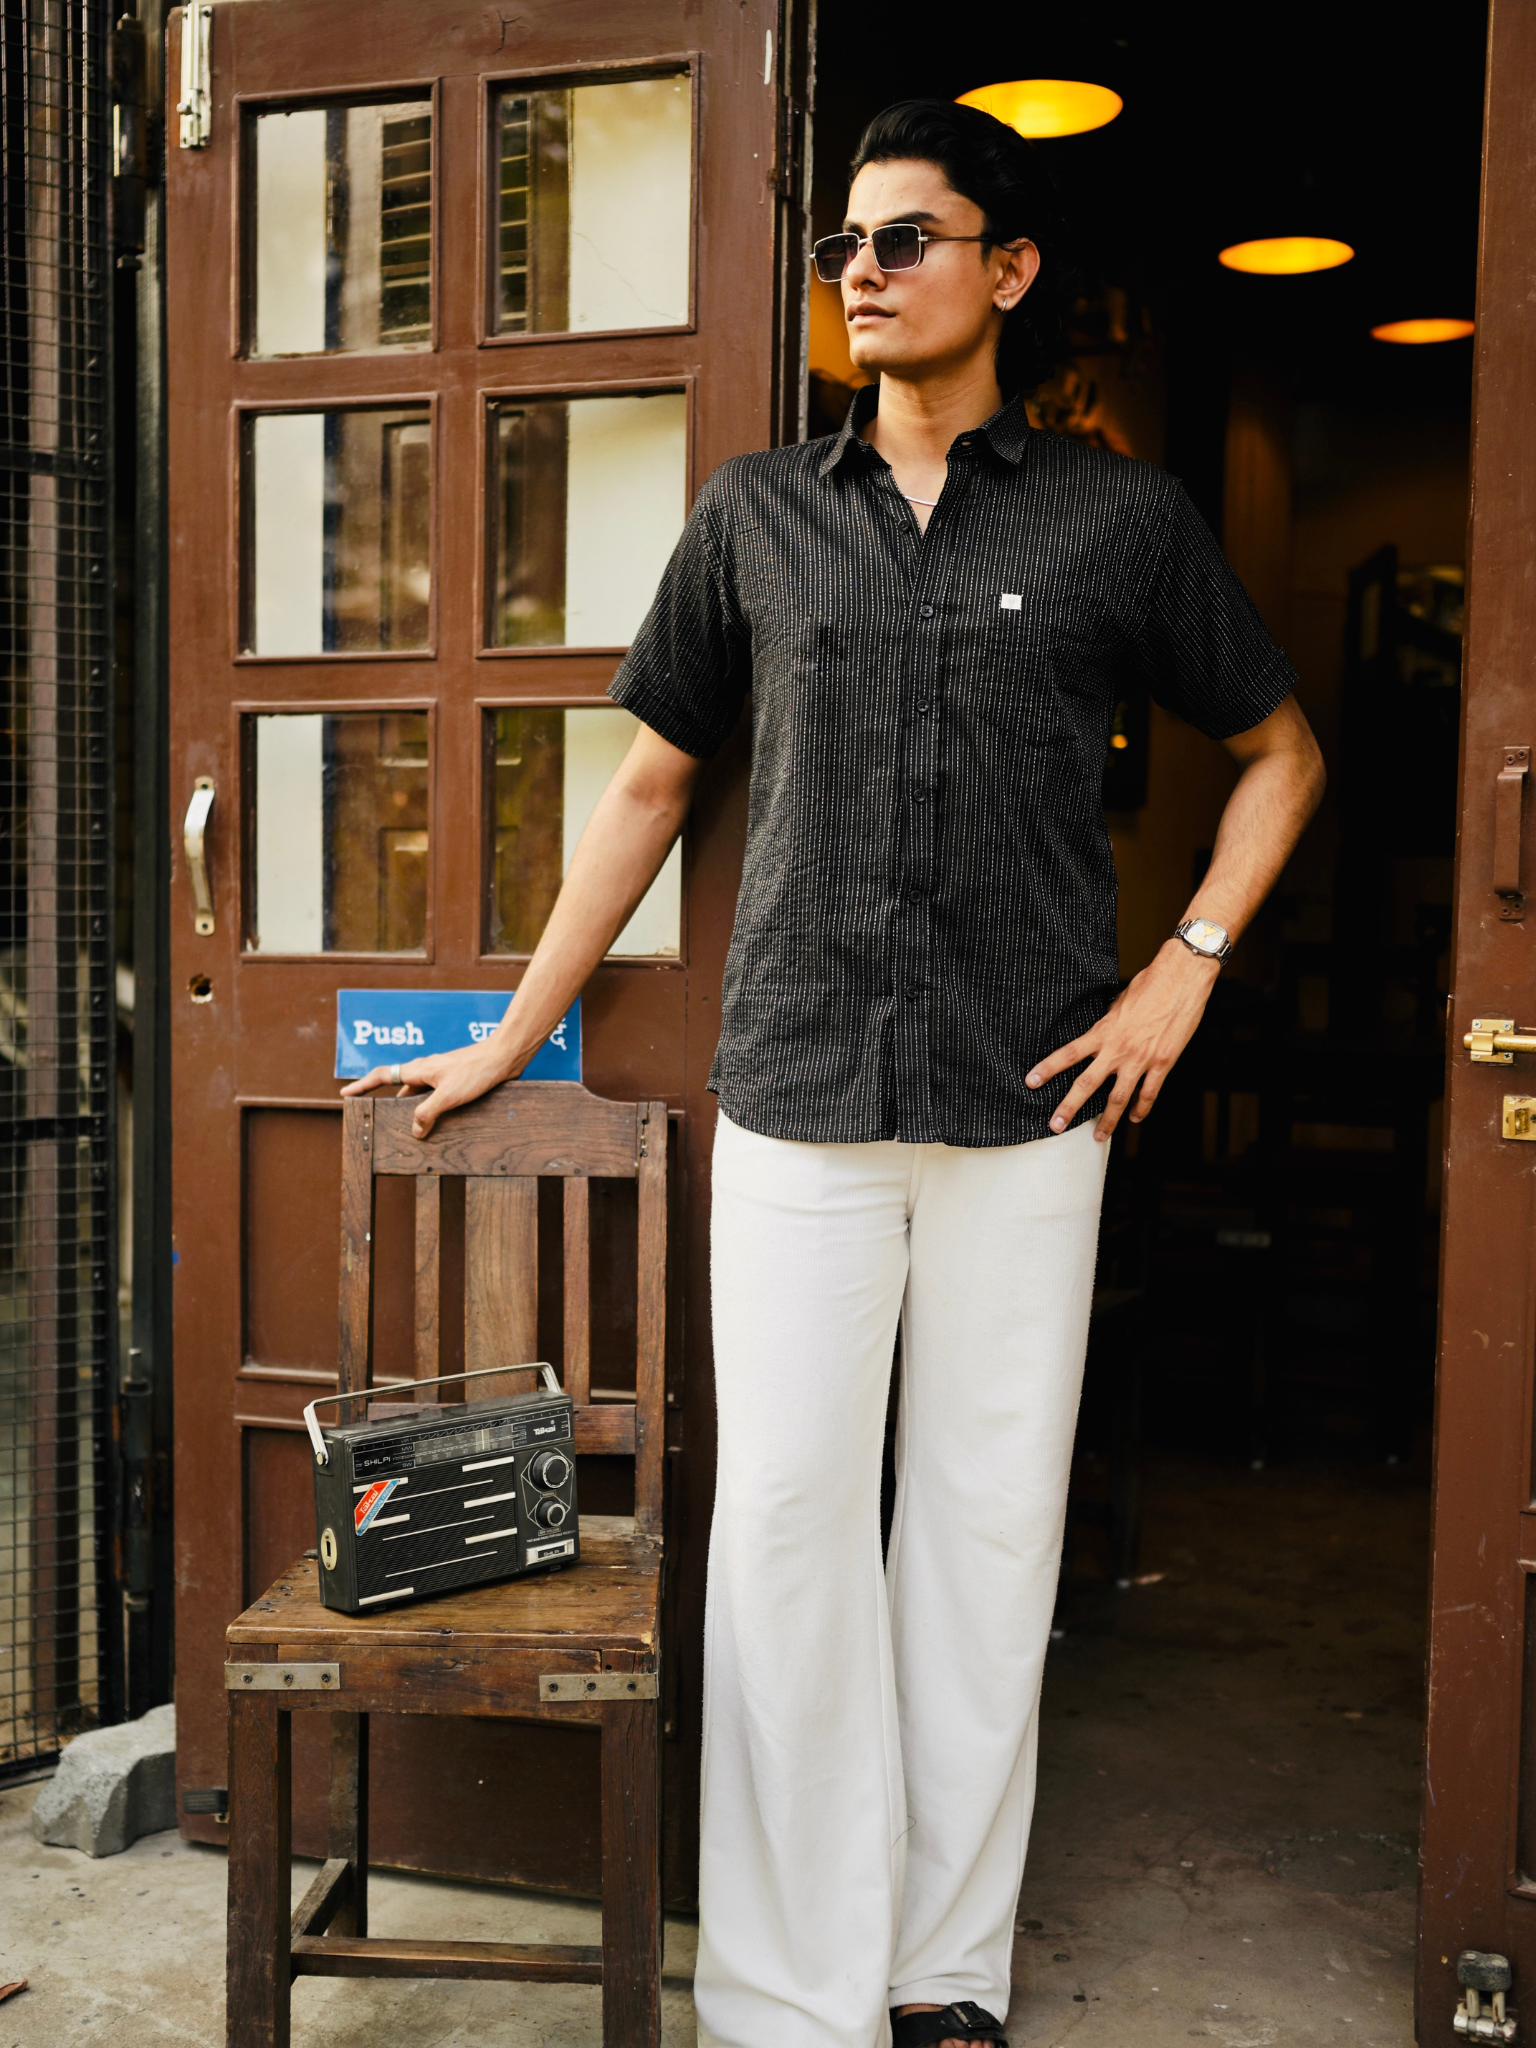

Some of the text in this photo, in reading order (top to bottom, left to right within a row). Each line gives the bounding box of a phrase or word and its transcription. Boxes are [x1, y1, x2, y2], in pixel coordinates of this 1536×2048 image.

[353, 1020, 425, 1045] Push
[533, 1424, 556, 1436] Takai
[363, 1456, 391, 1467] SHILPI
[359, 1490, 379, 1514] Takai
